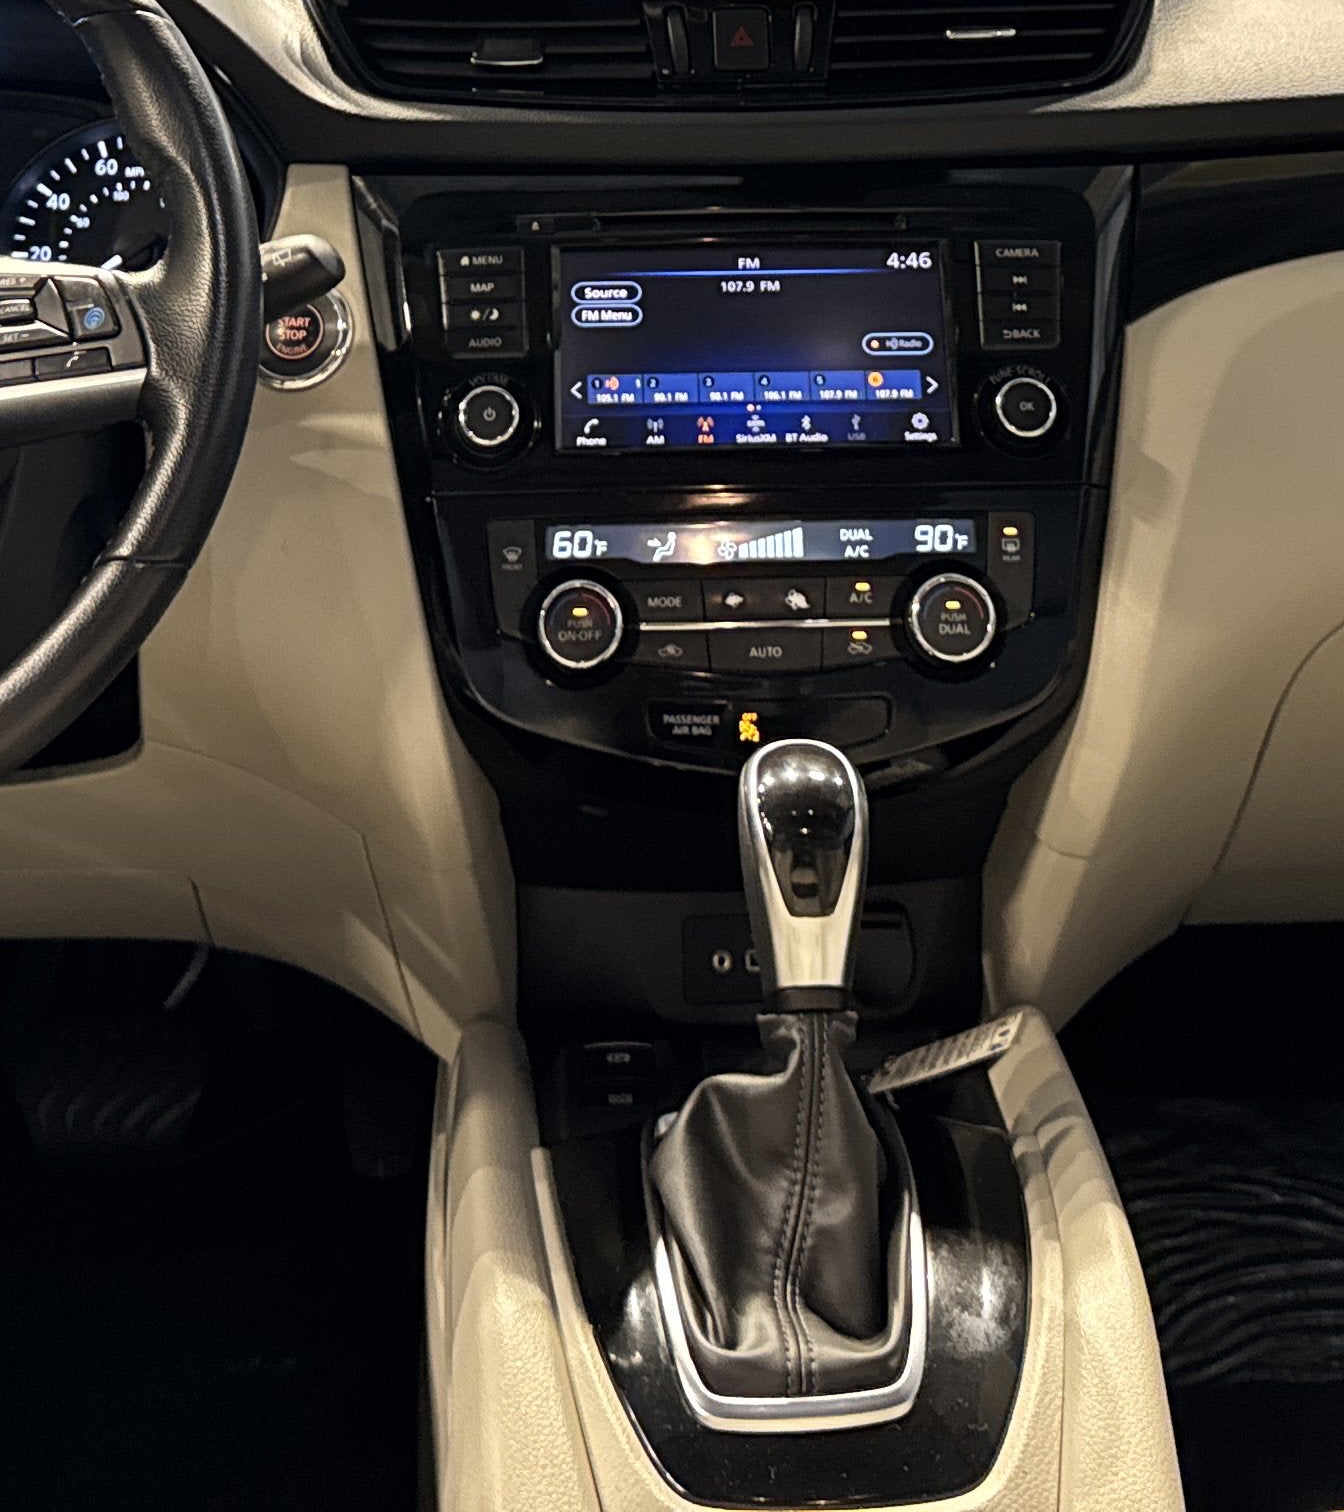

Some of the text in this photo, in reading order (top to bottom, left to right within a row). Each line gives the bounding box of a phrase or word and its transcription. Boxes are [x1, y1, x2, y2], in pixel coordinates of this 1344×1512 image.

[94, 158, 120, 176] 60
[46, 192, 71, 211] 40
[29, 245, 52, 261] 20
[995, 247, 1040, 258] CAMERA
[472, 255, 504, 266] MENU
[738, 257, 761, 269] FM
[886, 251, 932, 269] 4:46
[470, 282, 495, 293] MAP
[720, 280, 781, 293] 107.9 FM
[584, 287, 628, 300] Source
[278, 316, 312, 328] START
[581, 310, 633, 322] FM Menu
[278, 329, 308, 341] STOP
[1012, 328, 1041, 338] BACK
[468, 337, 503, 348] AUDIO
[621, 393, 635, 403] FM
[674, 392, 689, 402] FM
[730, 391, 745, 401] FM
[788, 390, 802, 400] FM
[819, 389, 858, 400] 107.9 FM
[900, 388, 914, 399] FM
[1019, 401, 1035, 411] OK
[576, 435, 607, 447] Phone
[645, 434, 665, 446] AM
[697, 434, 714, 445] FM
[735, 433, 777, 444] SiriusXM
[785, 432, 829, 443] BT Audio
[904, 430, 938, 443] Settings
[839, 527, 874, 542] DUAL
[844, 545, 870, 559] A/C
[647, 596, 683, 608] MODE
[849, 592, 874, 604] A/C
[940, 611, 968, 622] PUSH
[938, 623, 972, 636] DUAL
[558, 630, 603, 642] ON-OFF
[749, 646, 783, 658] AUTO
[662, 713, 721, 726] PASSENGER
[671, 725, 713, 737] AIR BAG
